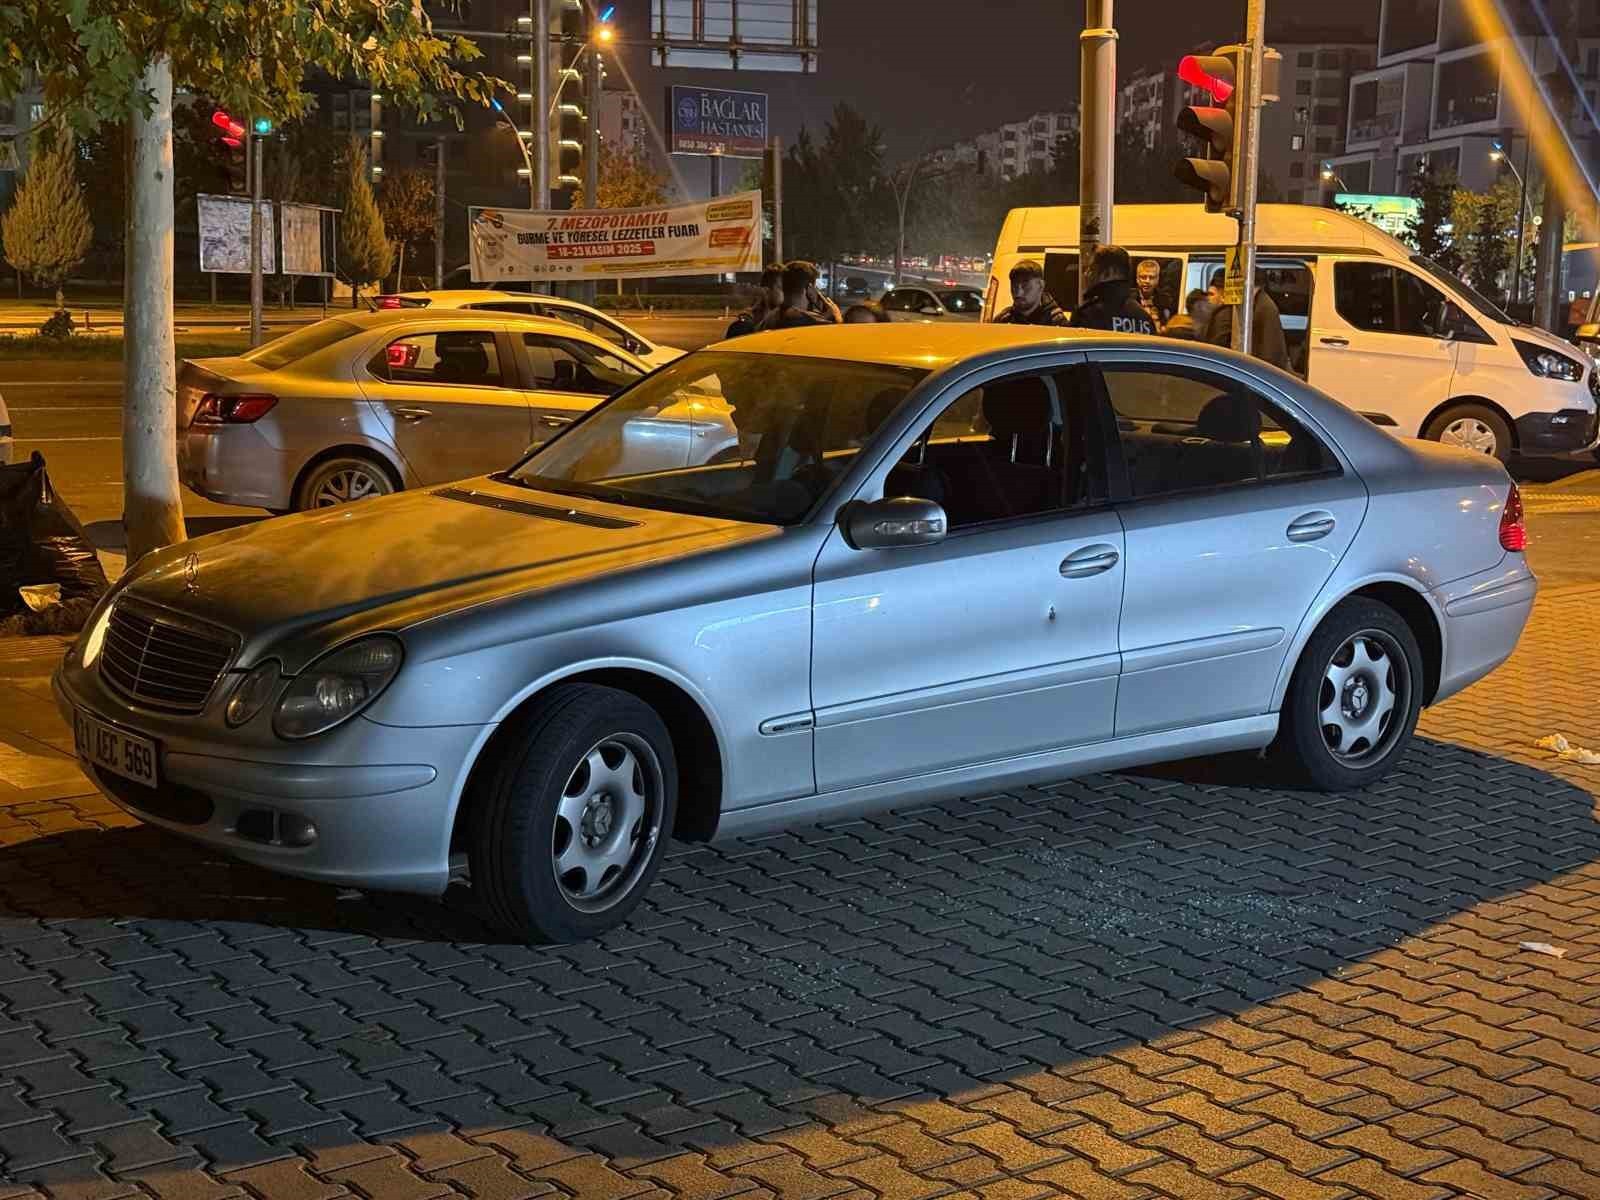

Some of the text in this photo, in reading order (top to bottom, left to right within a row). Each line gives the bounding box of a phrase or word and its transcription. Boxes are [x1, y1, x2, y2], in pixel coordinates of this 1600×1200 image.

[560, 212, 668, 230] MEZOPOTAMYA
[552, 231, 565, 243] VE
[612, 226, 665, 241] LEZZETLER
[667, 223, 699, 238] FUARI
[585, 244, 615, 256] KASIM
[616, 243, 642, 255] 2025
[124, 738, 152, 779] 569
